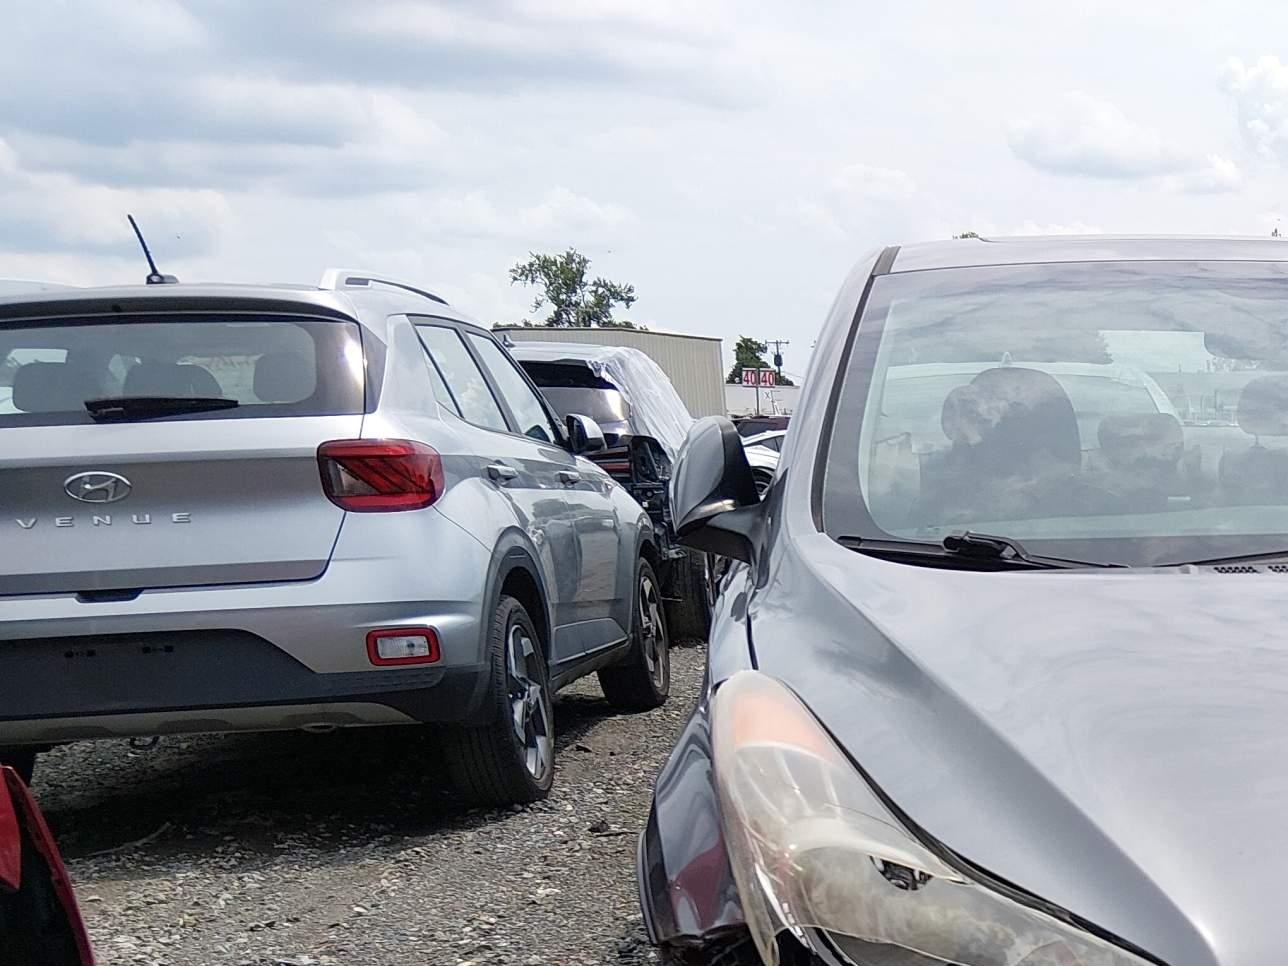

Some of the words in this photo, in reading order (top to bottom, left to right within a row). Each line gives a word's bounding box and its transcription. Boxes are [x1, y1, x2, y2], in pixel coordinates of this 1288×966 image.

[744, 371, 757, 385] 40
[761, 372, 774, 386] 40
[15, 512, 192, 529] VENUE
